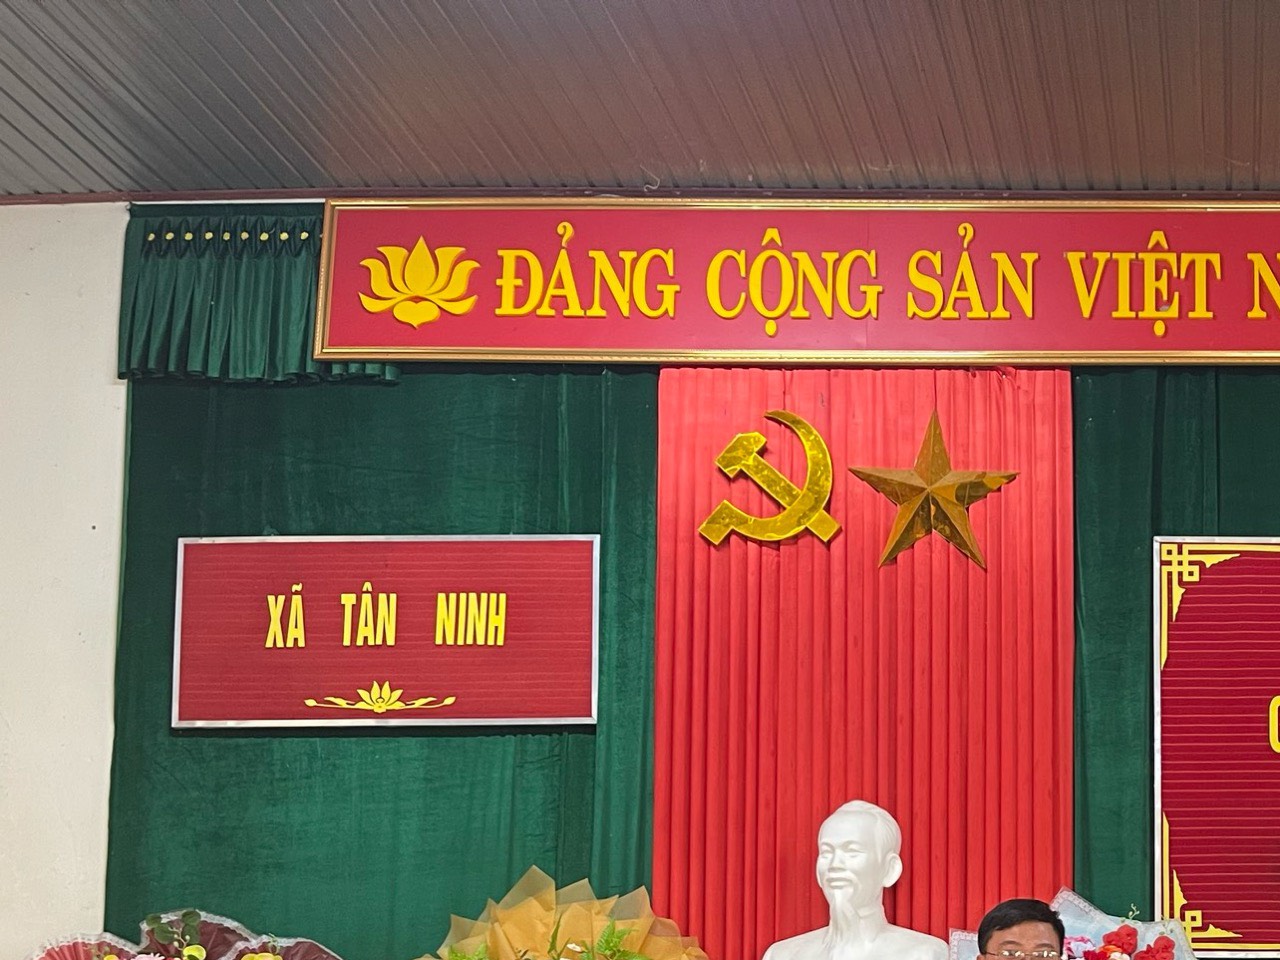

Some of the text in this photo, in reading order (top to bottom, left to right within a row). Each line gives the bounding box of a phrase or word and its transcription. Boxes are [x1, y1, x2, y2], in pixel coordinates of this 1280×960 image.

[495, 222, 681, 318] ĐẢNG
[705, 227, 882, 337] CỘNG
[906, 223, 1038, 319] SẢN
[1065, 230, 1221, 337] VIỆT
[265, 581, 507, 648] XÃ TÂN NINH
